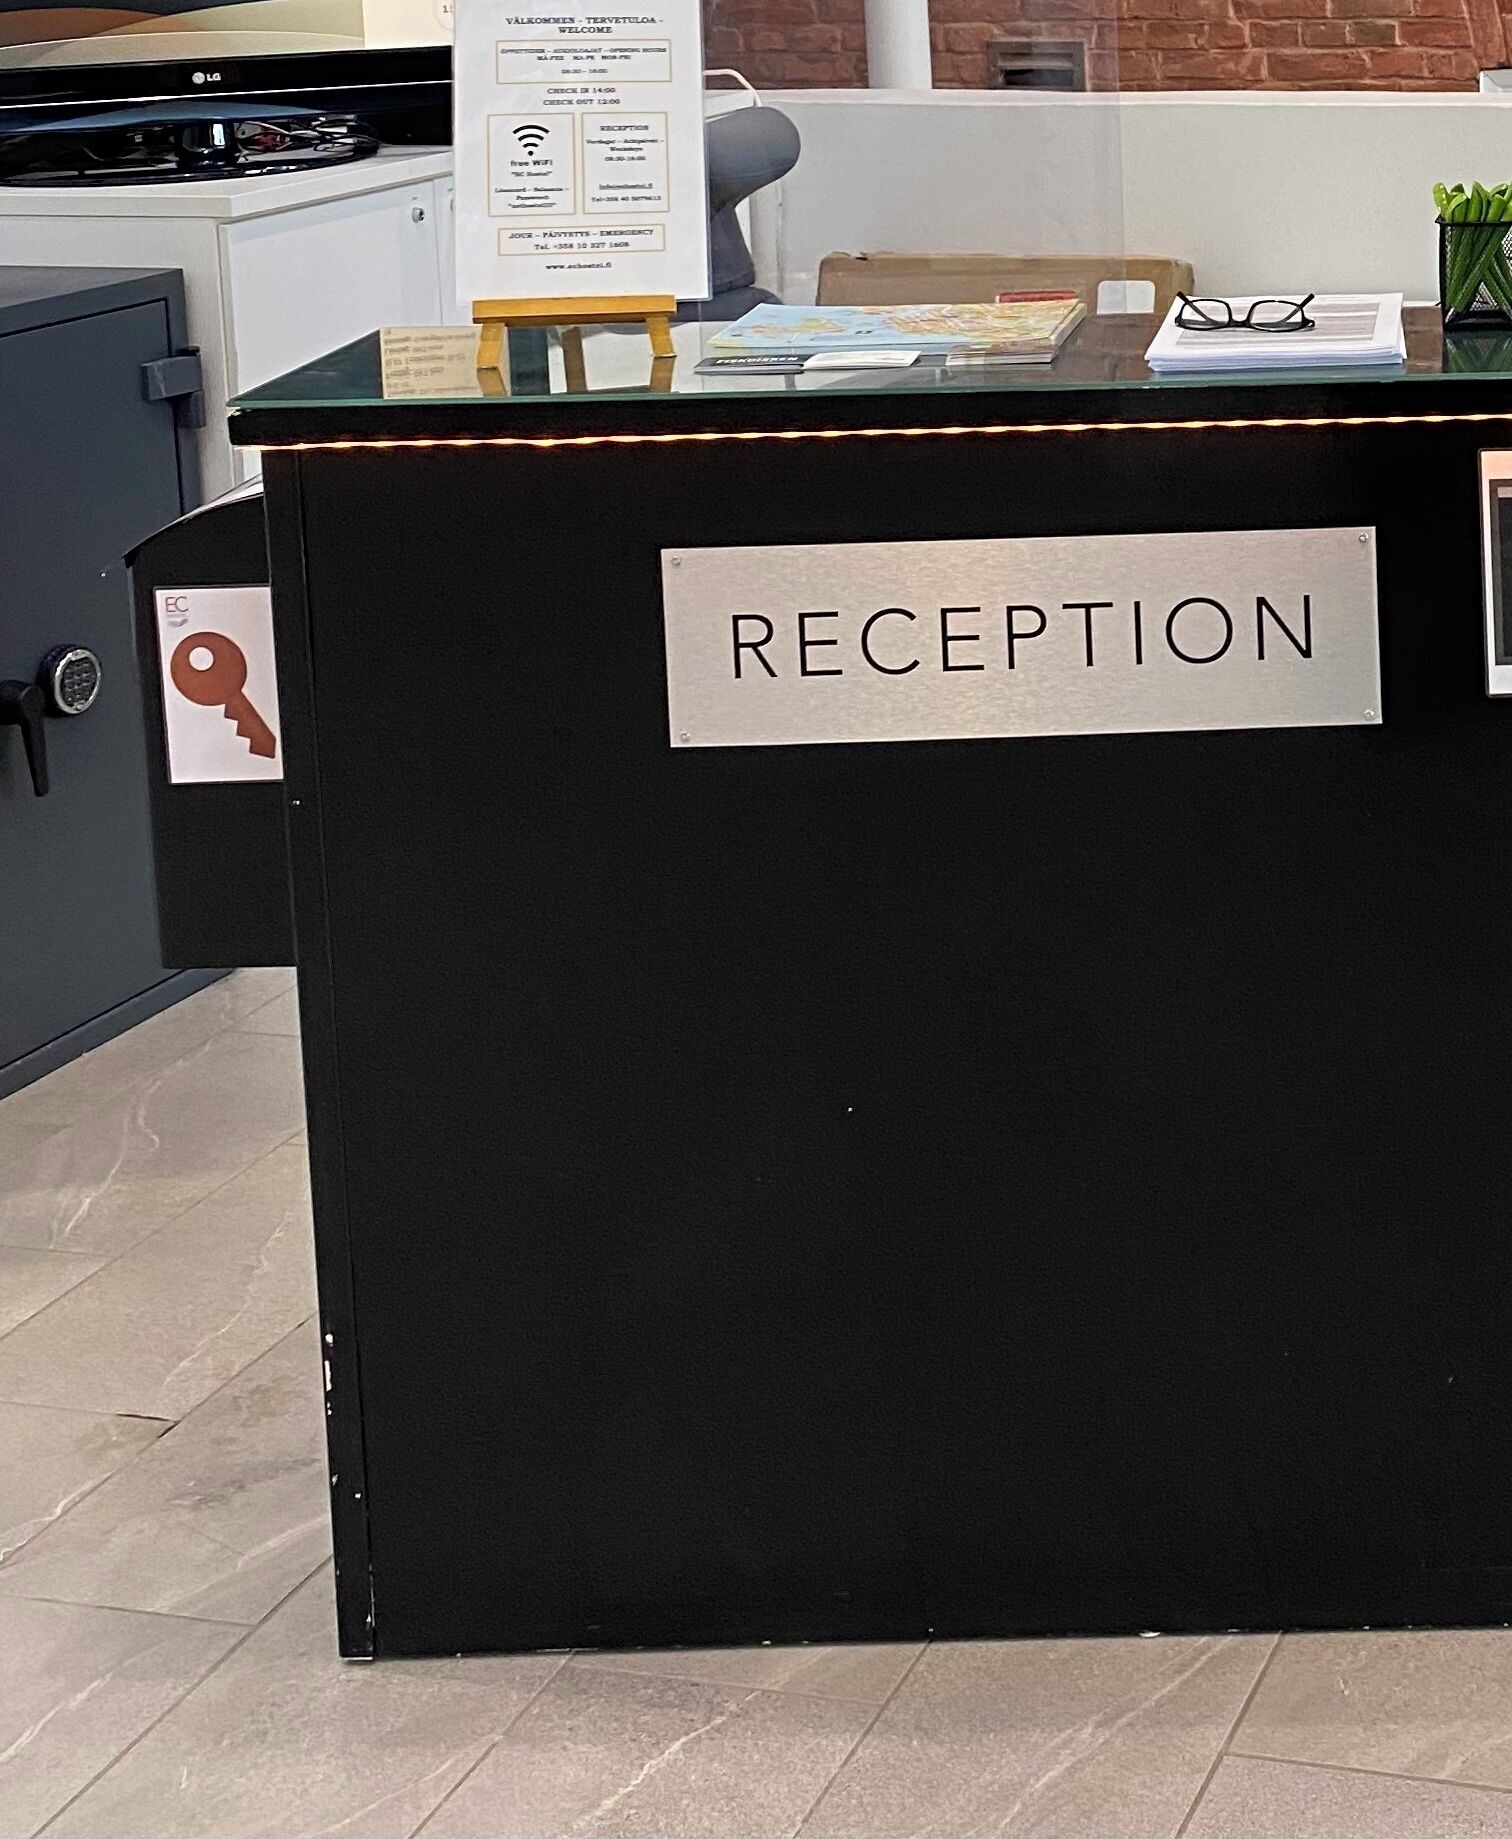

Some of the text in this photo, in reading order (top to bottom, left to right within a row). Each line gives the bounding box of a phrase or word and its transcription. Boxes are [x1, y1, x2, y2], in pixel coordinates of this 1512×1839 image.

[505, 15, 576, 25] VÄLKOMMEN
[585, 16, 657, 25] TERVETULOA
[558, 26, 613, 34] WELCOME
[206, 72, 222, 82] LG
[543, 98, 574, 106] CHECK
[165, 596, 190, 613] EC
[730, 593, 1316, 681] RECEPTION
